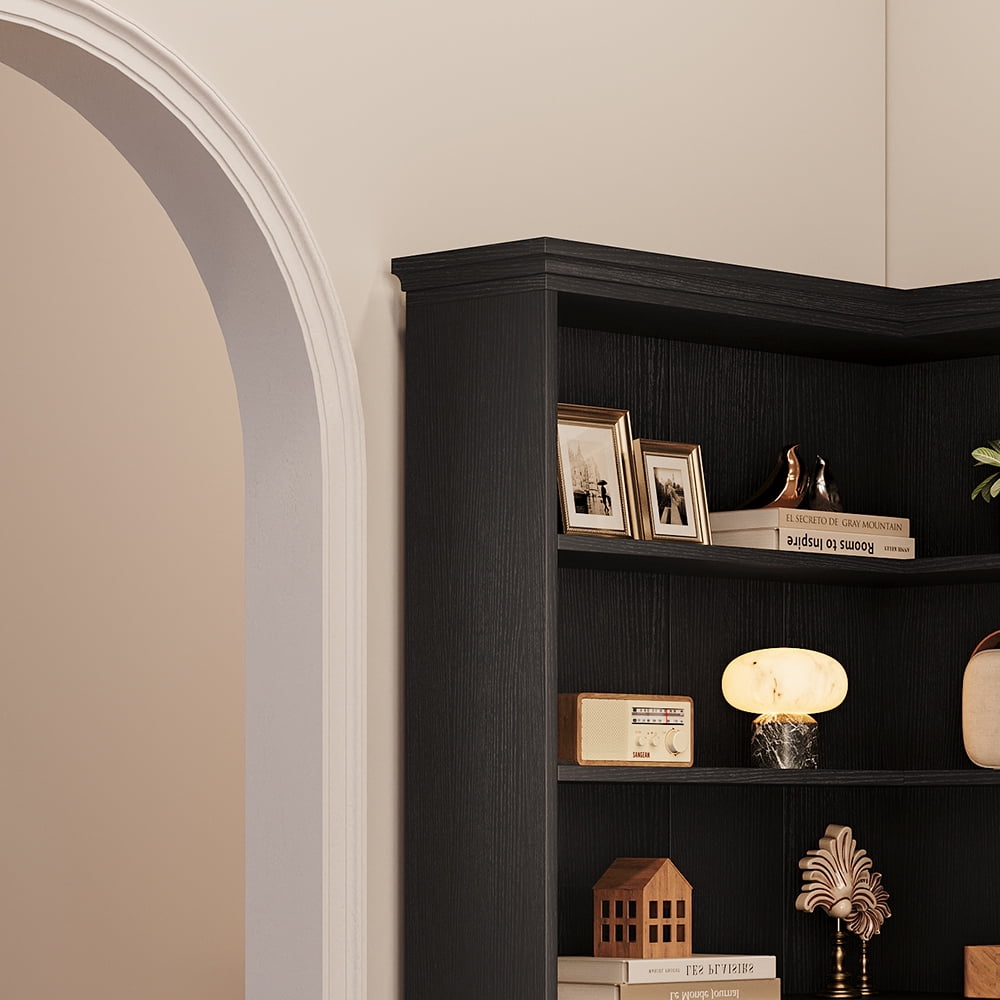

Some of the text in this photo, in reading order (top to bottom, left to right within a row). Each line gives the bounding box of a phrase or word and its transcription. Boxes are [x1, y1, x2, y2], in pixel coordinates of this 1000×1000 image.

[786, 514, 902, 531] EL SECRETO DE GRAY MOUNTAIN
[787, 533, 874, 554] Rooms to Inspire
